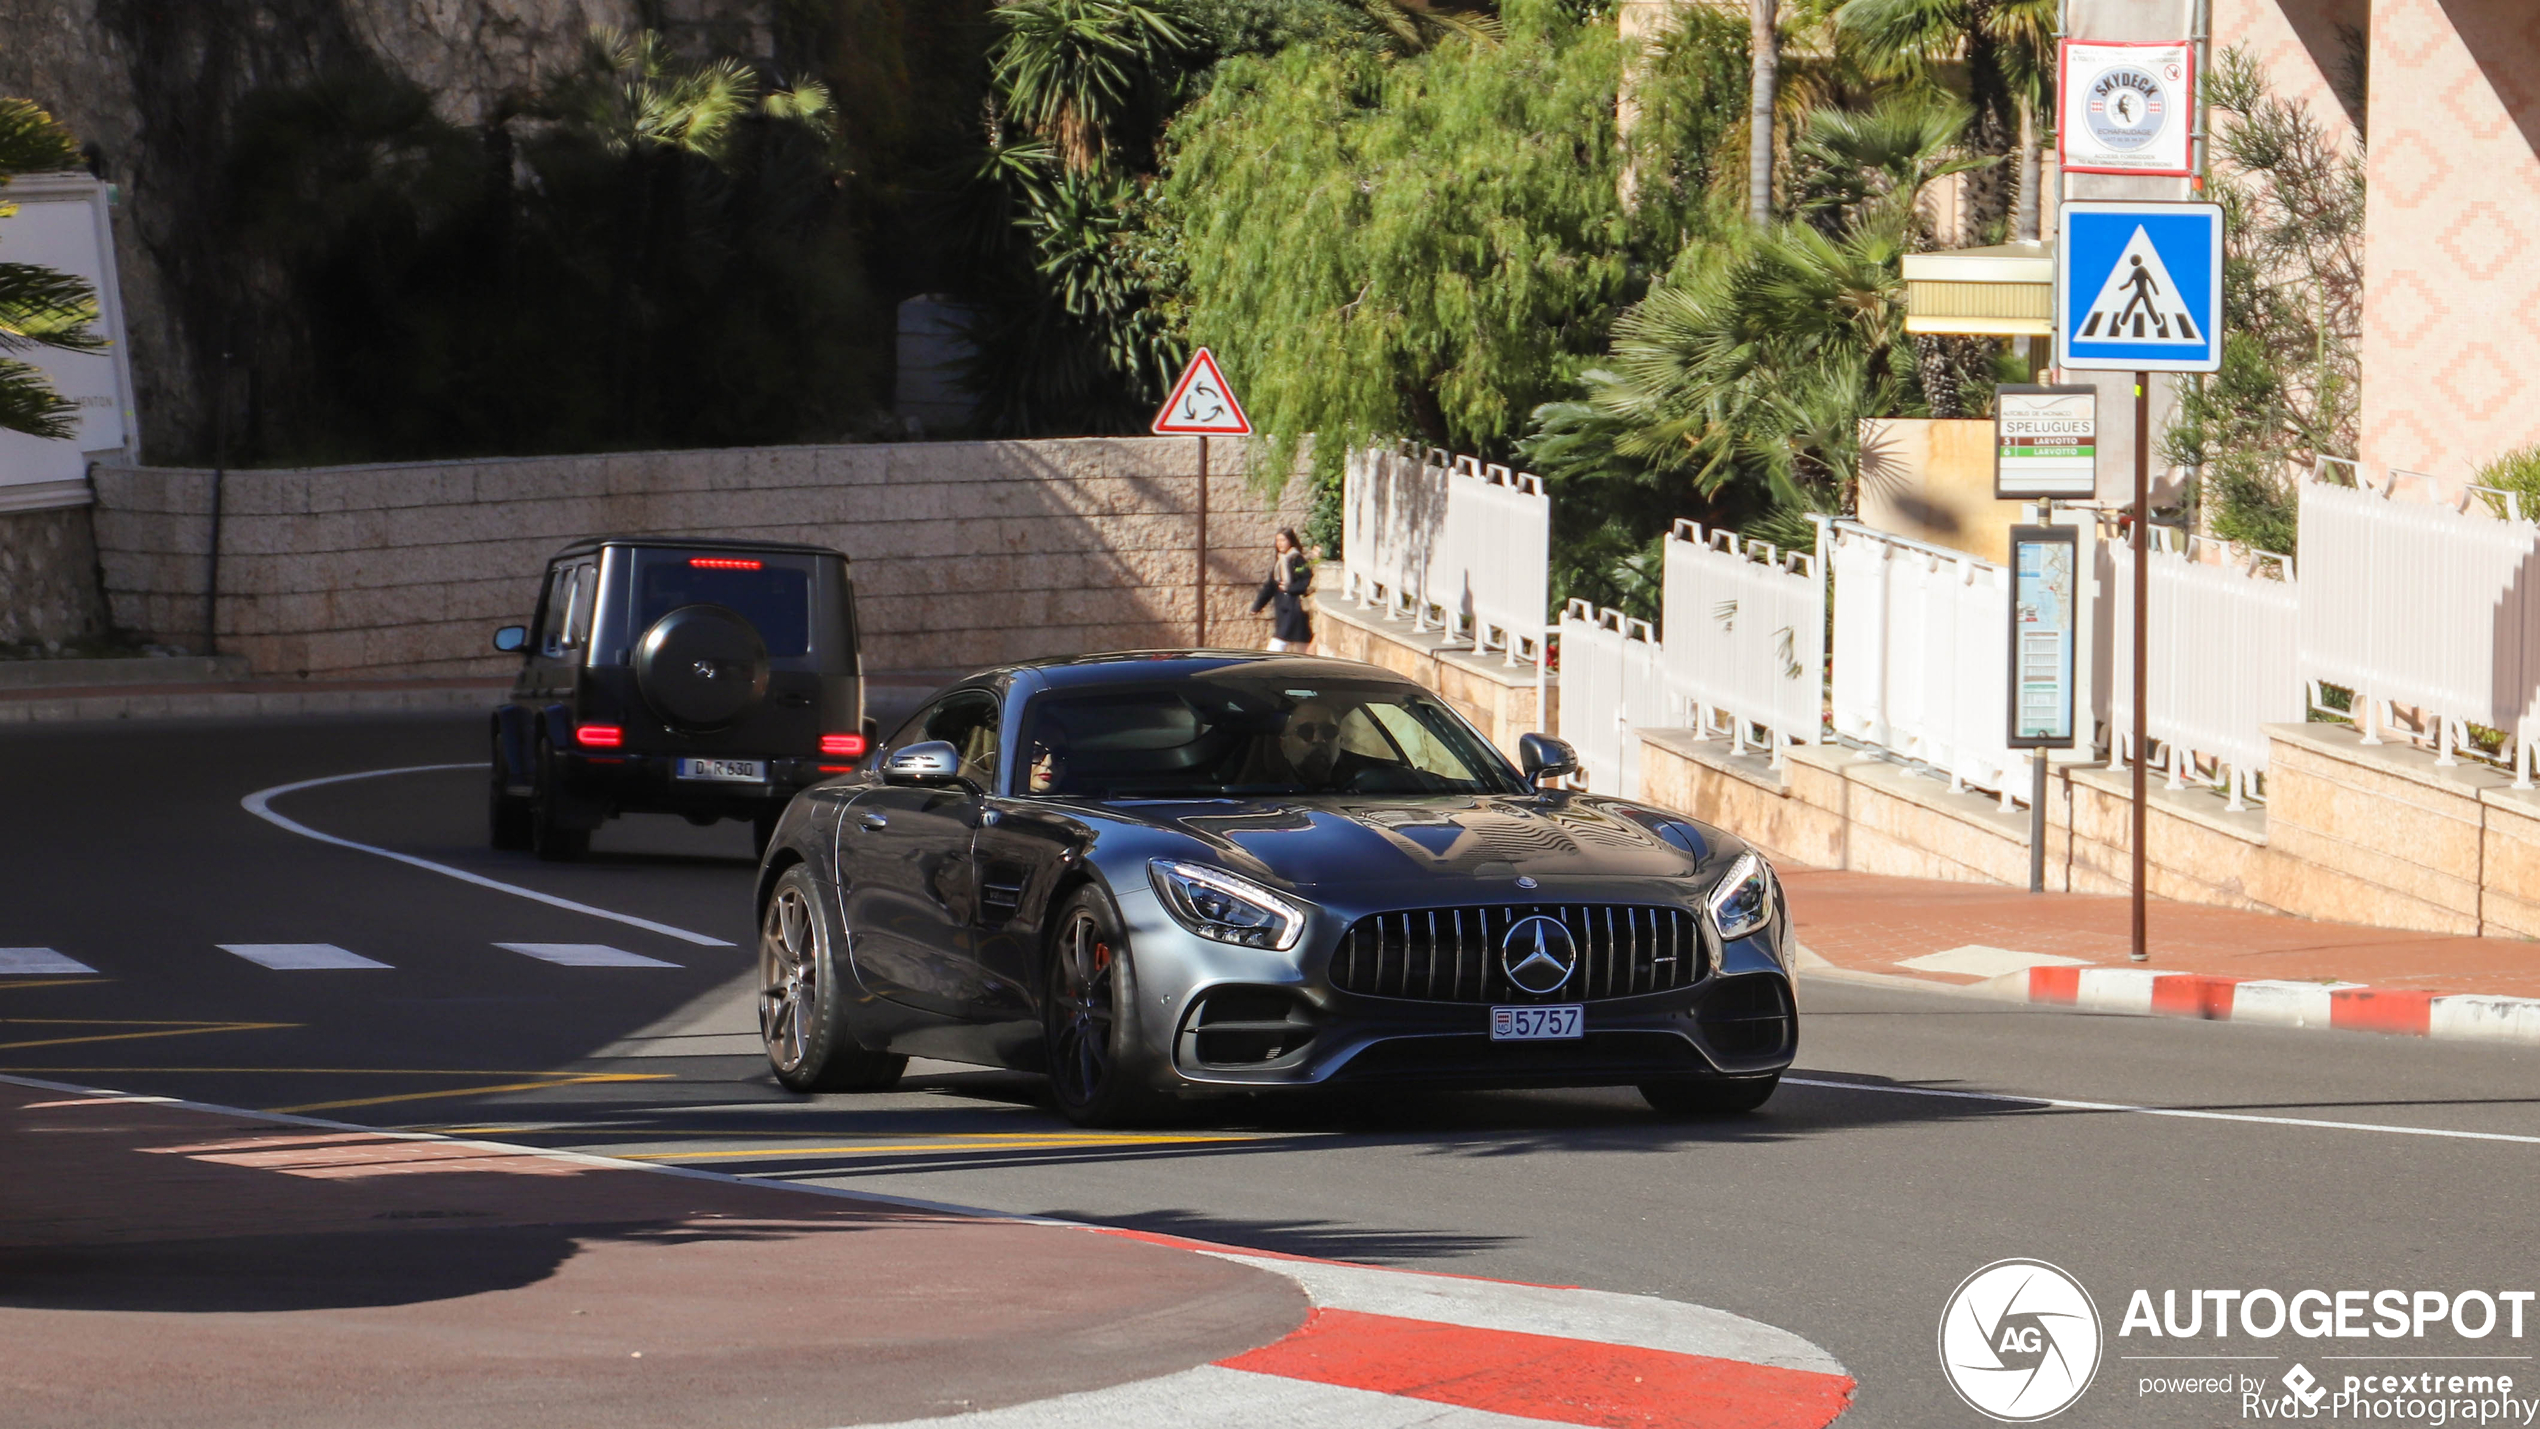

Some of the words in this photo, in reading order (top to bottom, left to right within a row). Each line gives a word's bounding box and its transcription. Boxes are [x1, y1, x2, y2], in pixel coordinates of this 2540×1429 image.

[2096, 73, 2159, 98] SKYDECK
[2097, 128, 2152, 136] ECHAFAUDAGE
[2006, 421, 2090, 433] SPELUGUES
[2004, 437, 2011, 445] 5
[2033, 437, 2078, 445] LARVOTTO
[2003, 448, 2011, 456] 6
[2033, 448, 2078, 456] LARVOTTO
[696, 761, 704, 775] D
[714, 761, 723, 775] R
[1497, 1023, 1509, 1031] MC
[1515, 1009, 1578, 1035] 5757
